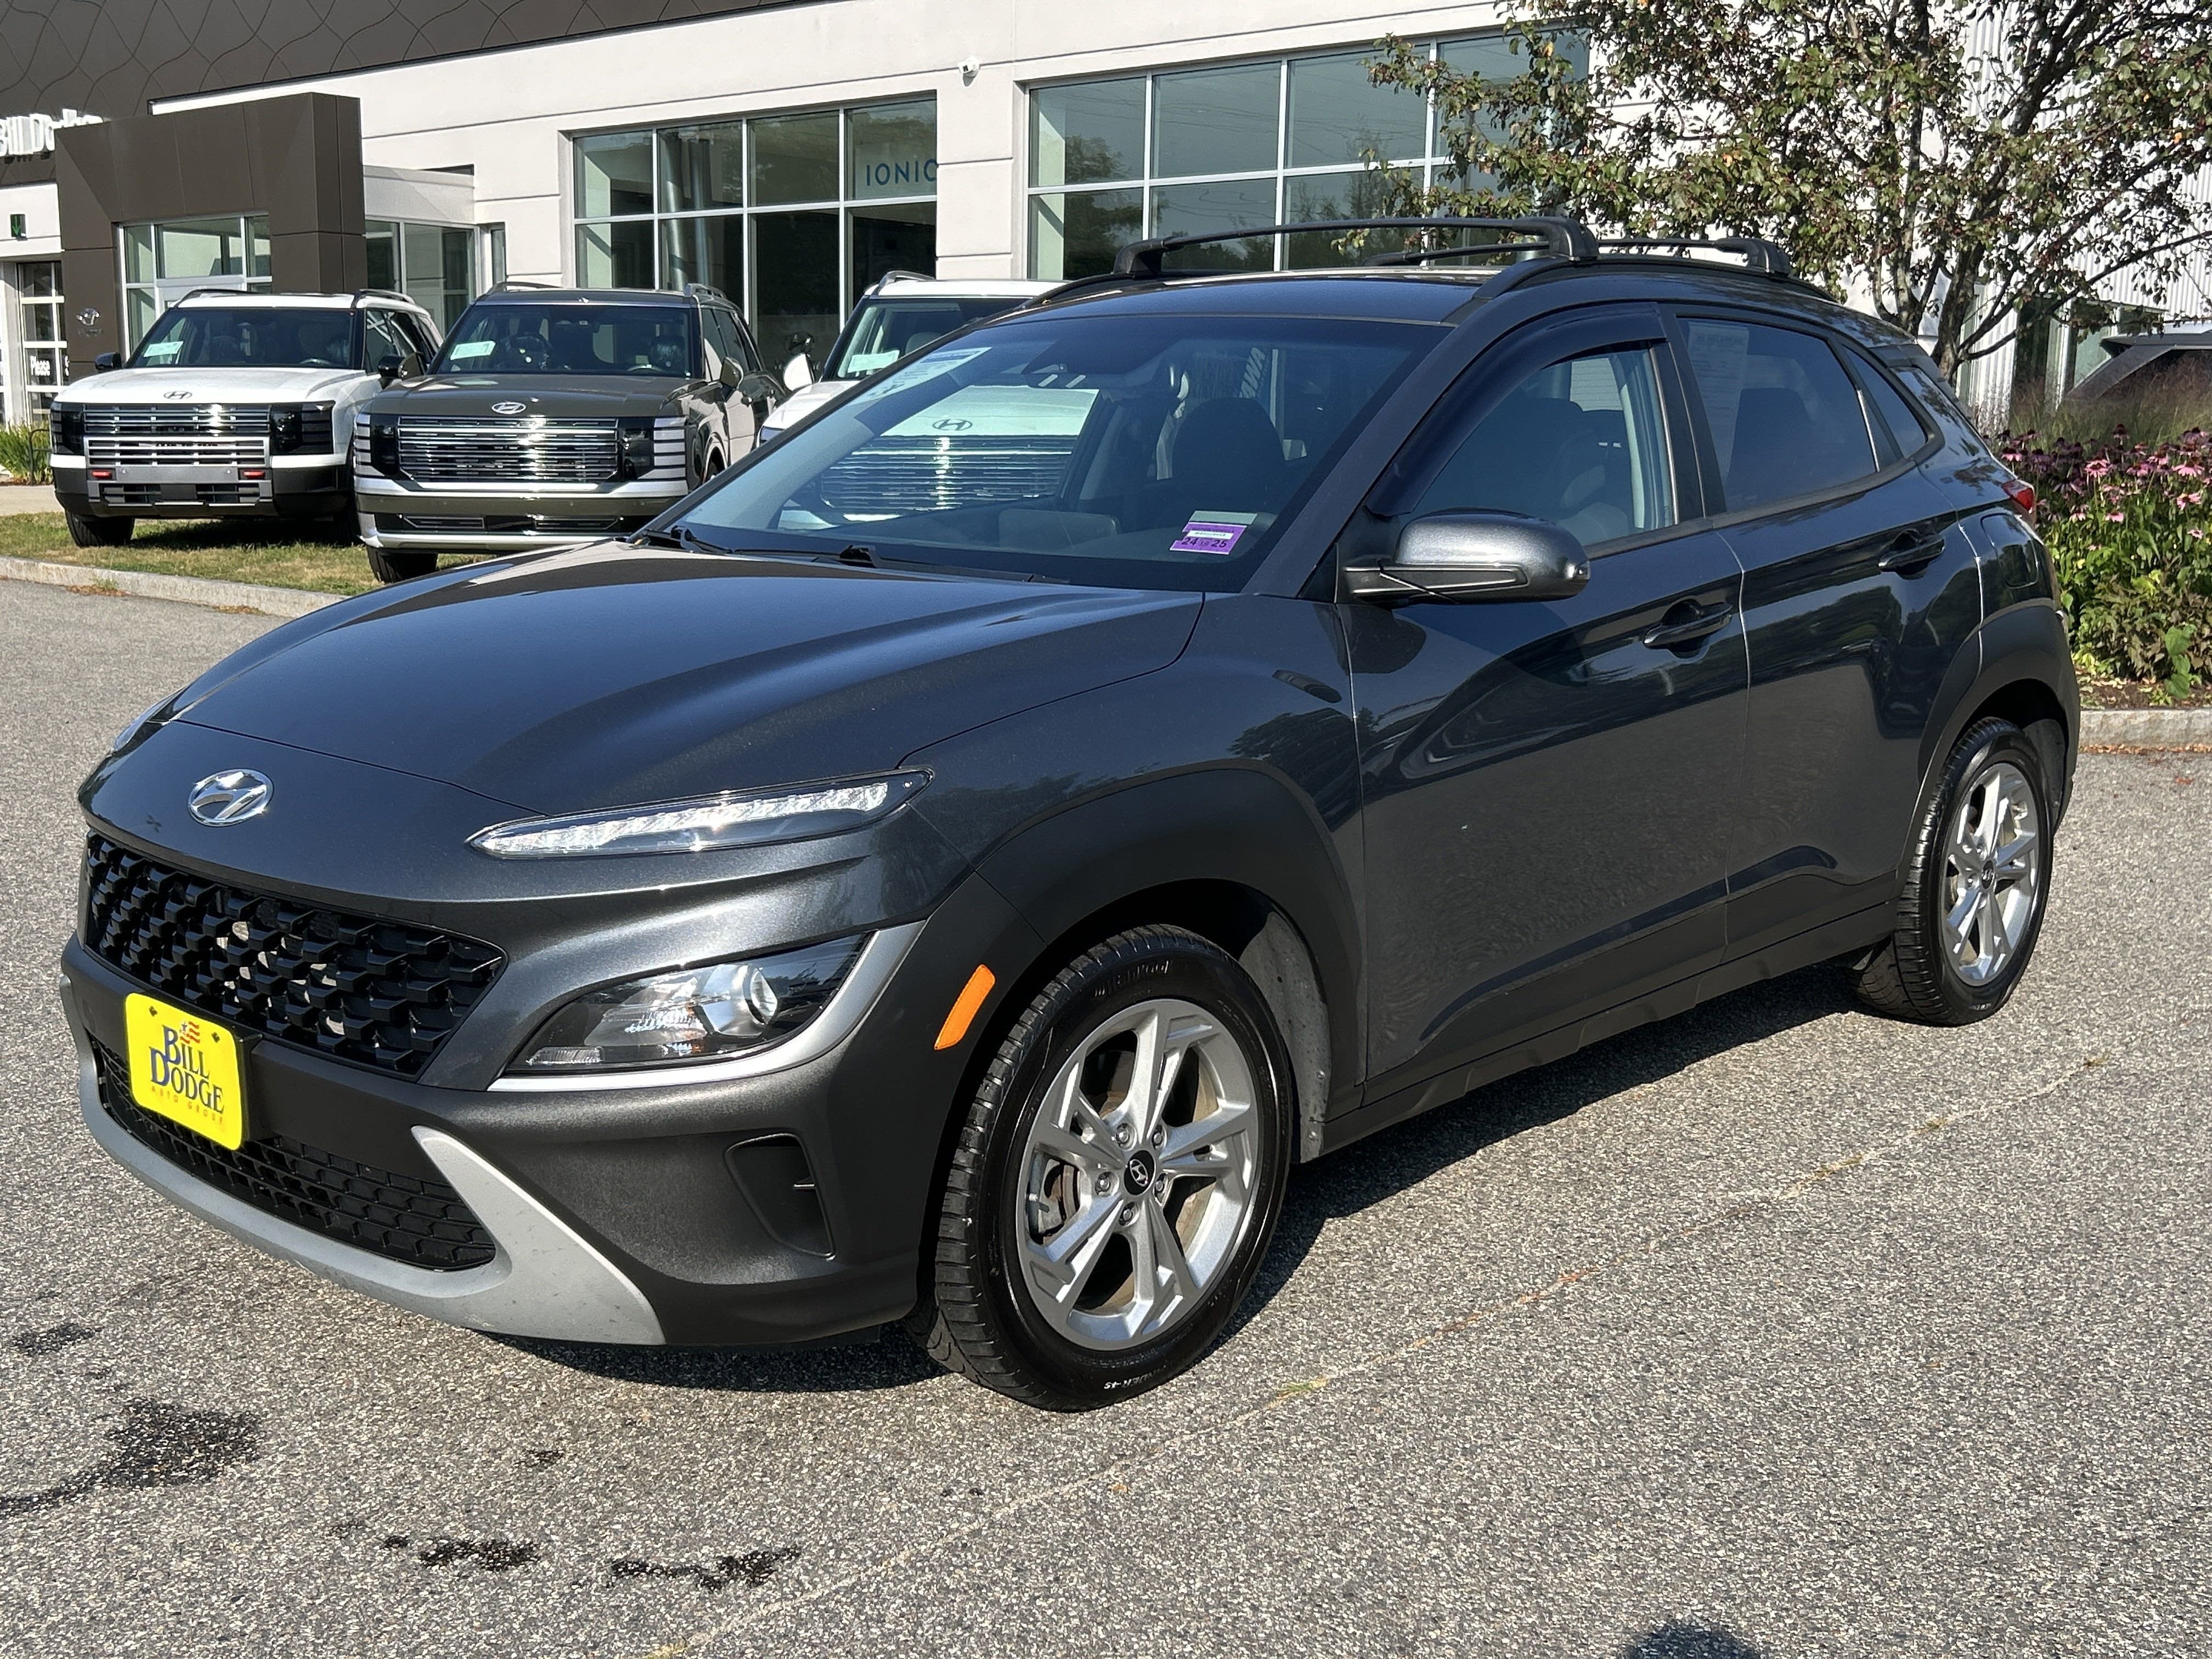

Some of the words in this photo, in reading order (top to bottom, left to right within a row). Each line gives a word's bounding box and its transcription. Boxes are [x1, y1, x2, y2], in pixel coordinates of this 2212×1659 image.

[1211, 539, 1227, 548] 25
[162, 1024, 210, 1079] BILL
[149, 1046, 225, 1114] DODGE
[151, 1085, 179, 1103] AUTO
[187, 1101, 223, 1125] GROUP
